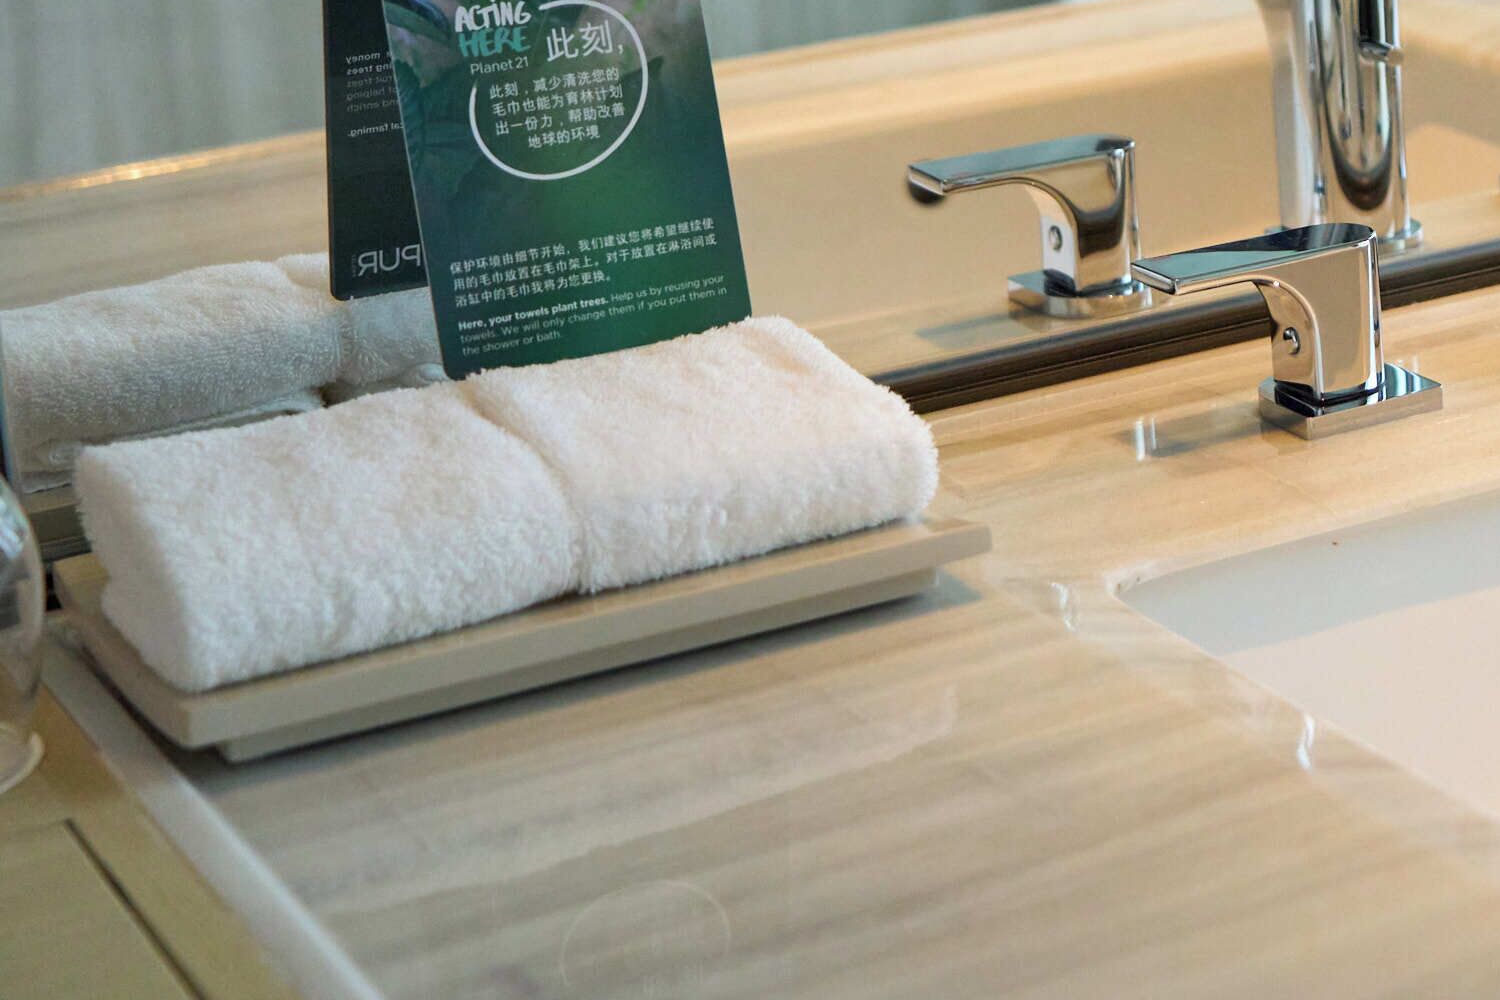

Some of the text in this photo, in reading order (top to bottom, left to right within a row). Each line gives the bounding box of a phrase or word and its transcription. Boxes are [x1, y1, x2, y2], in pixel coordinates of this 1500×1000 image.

[458, 25, 531, 58] HERE
[469, 55, 529, 76] Planet 21
[492, 83, 624, 118] 毛巾也能为育林计划
[527, 124, 601, 150] 地球的环境
[488, 314, 513, 327] your
[515, 306, 550, 320] towels
[551, 300, 578, 315] plant
[580, 296, 609, 309] trees.
[610, 290, 634, 303] Help
[636, 289, 648, 298] us
[649, 285, 663, 296] by
[664, 279, 701, 293] reusing
[702, 274, 724, 288] your
[501, 325, 520, 336] We
[522, 321, 541, 332] will
[542, 316, 566, 328] only
[567, 309, 606, 325] change
[608, 304, 636, 317] them
[638, 301, 646, 312] if
[647, 299, 667, 310] you
[669, 294, 687, 306] put
[689, 288, 716, 300] them
[717, 286, 728, 295] in
[461, 345, 480, 357] the
[481, 339, 520, 353] shower
[522, 336, 535, 345] or
